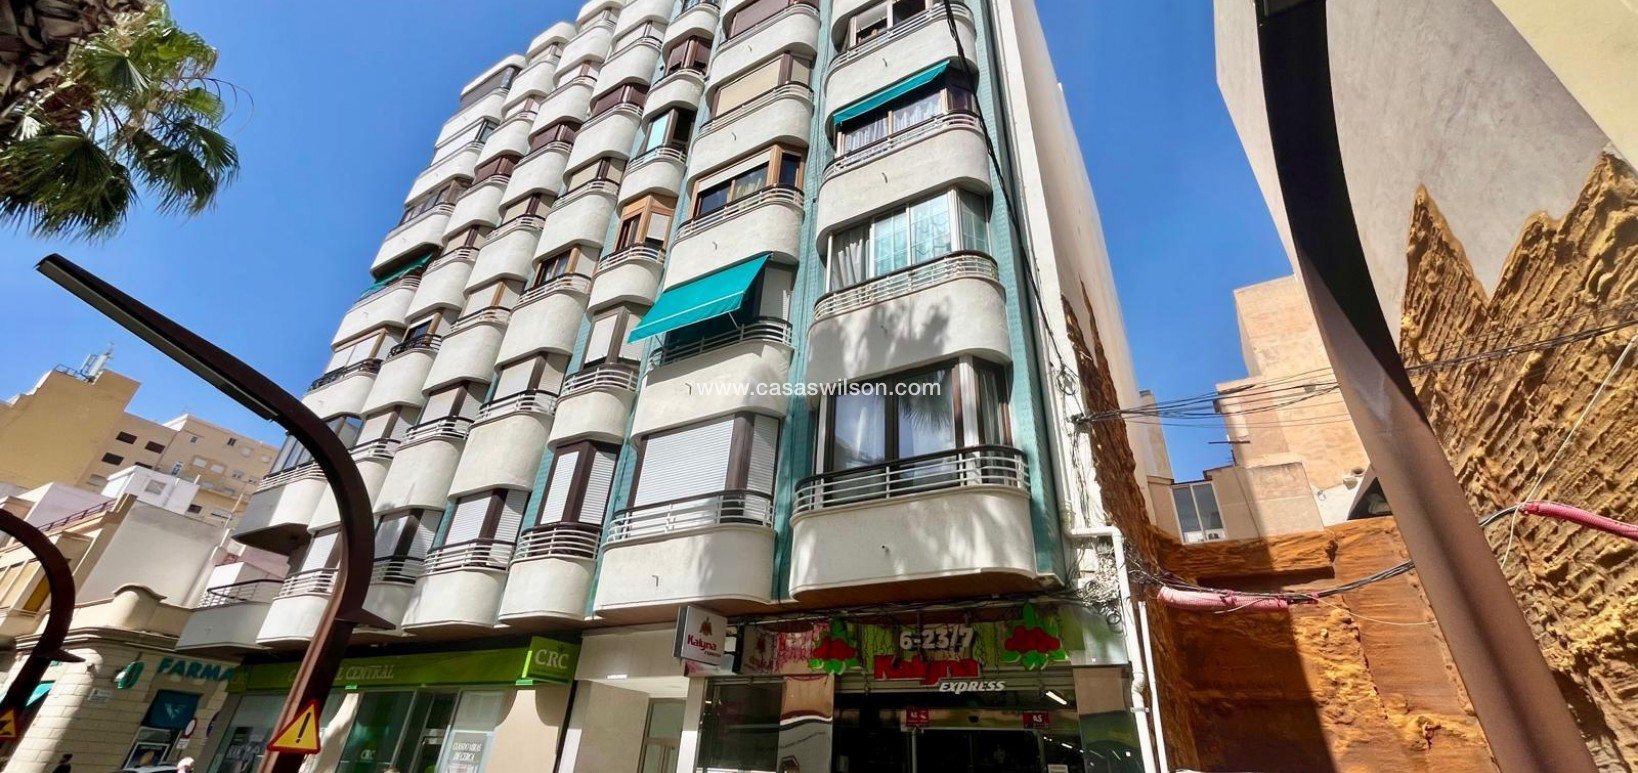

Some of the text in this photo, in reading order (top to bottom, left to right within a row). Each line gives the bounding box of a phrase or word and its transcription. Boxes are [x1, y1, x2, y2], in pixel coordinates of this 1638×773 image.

[687, 634, 717, 651] Kalyna
[534, 648, 569, 669] CRC
[345, 664, 395, 680] CENTRAL
